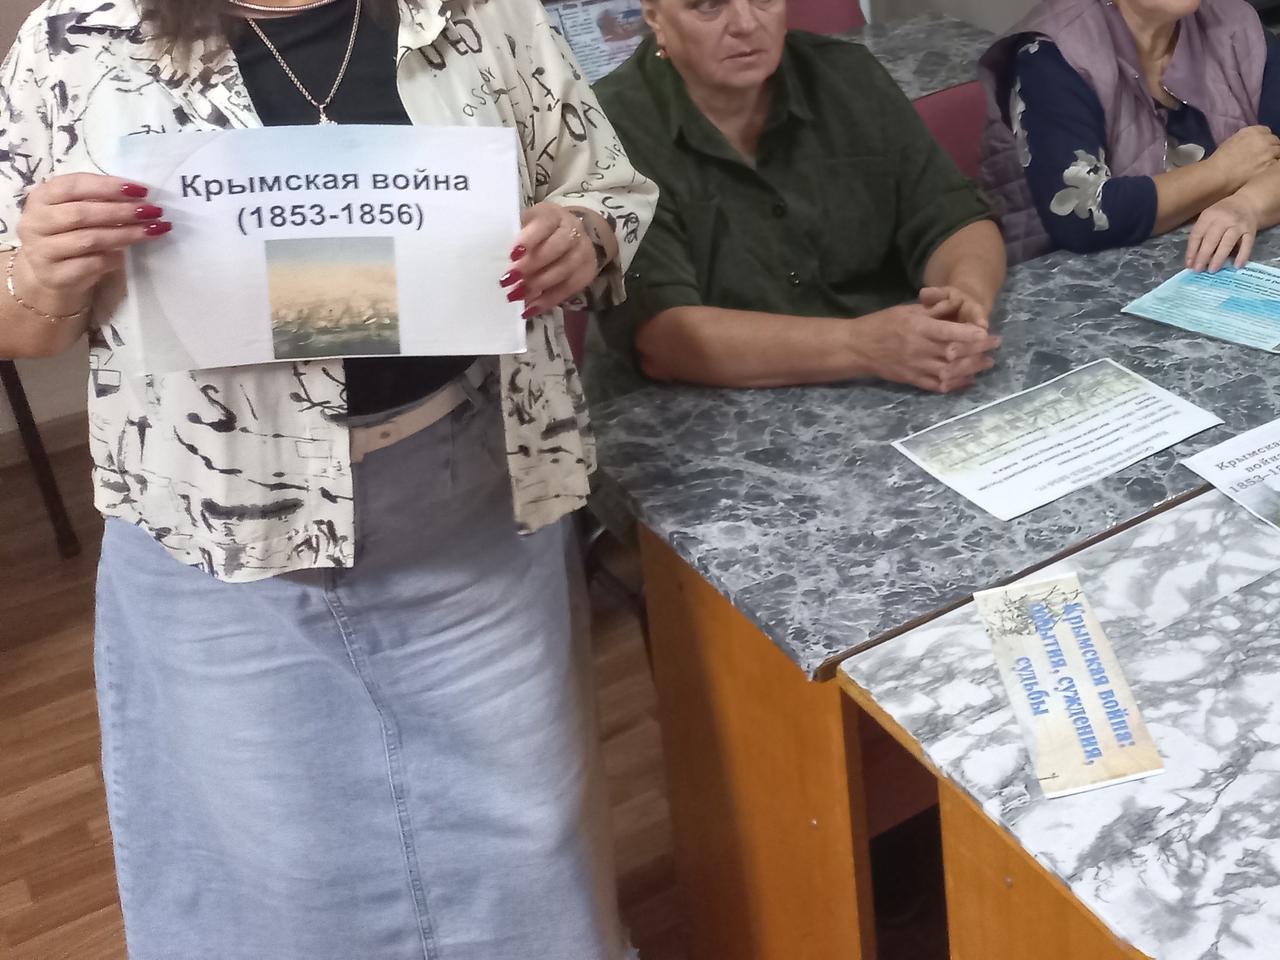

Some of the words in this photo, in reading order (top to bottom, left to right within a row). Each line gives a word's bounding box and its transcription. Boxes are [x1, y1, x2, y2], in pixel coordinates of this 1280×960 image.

[182, 173, 360, 201] Крымская
[372, 168, 470, 191] война
[237, 203, 425, 236] (1853-1856)
[1011, 656, 1050, 716] судьбы
[1063, 602, 1110, 687] Крымская
[1098, 689, 1136, 748] война:
[1053, 676, 1103, 765] суждения,
